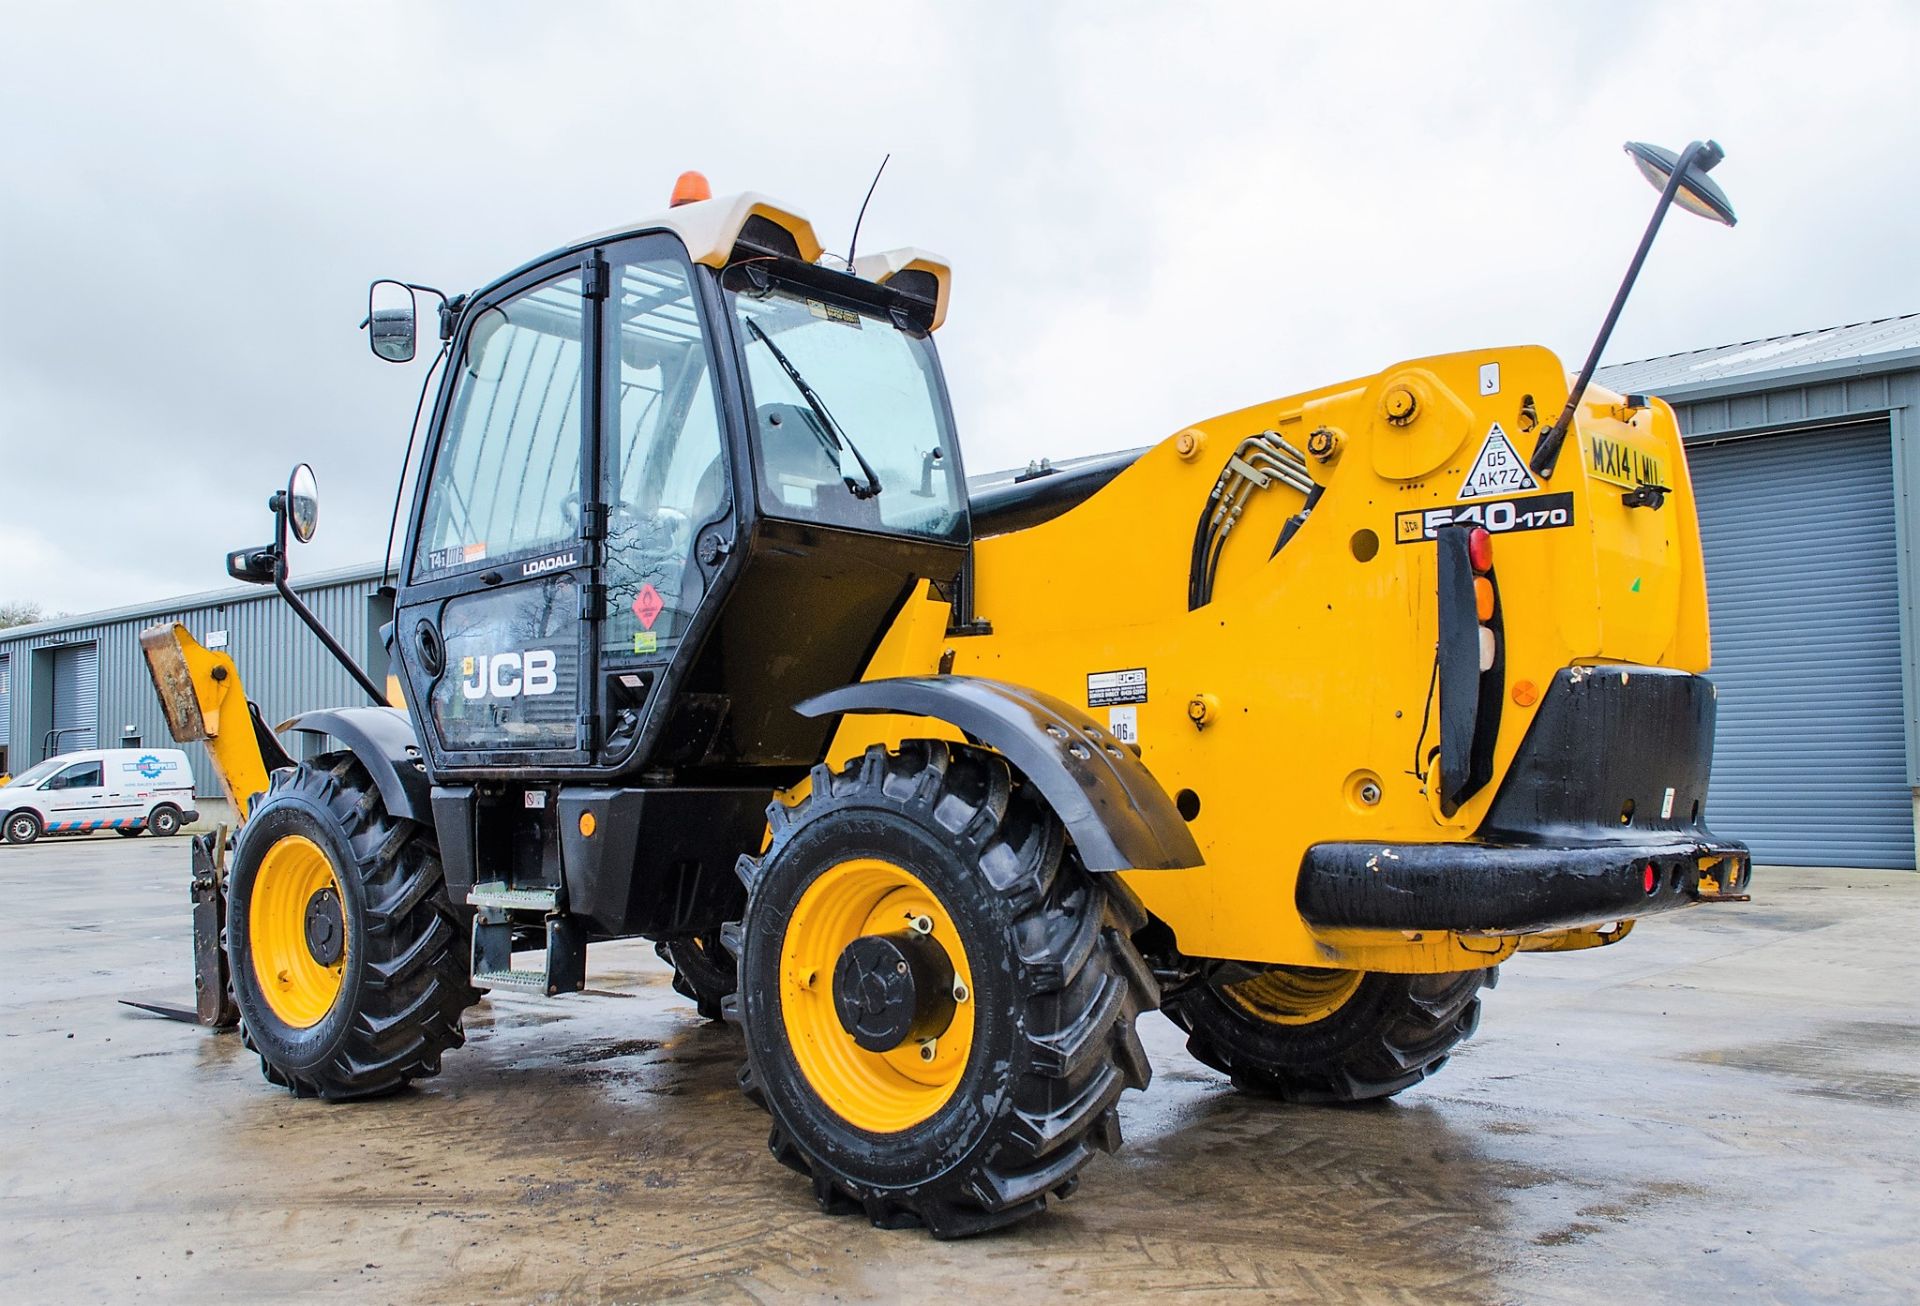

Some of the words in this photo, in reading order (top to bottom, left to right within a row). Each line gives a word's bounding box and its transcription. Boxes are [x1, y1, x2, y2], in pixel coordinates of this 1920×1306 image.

[1592, 436, 1631, 481] MX14
[1479, 468, 1519, 487] AK7Z
[1404, 520, 1419, 534] JCB
[522, 552, 578, 576] LOADALL
[463, 649, 558, 699] JCB
[1118, 672, 1143, 684] JCB
[1112, 723, 1128, 740] 106
